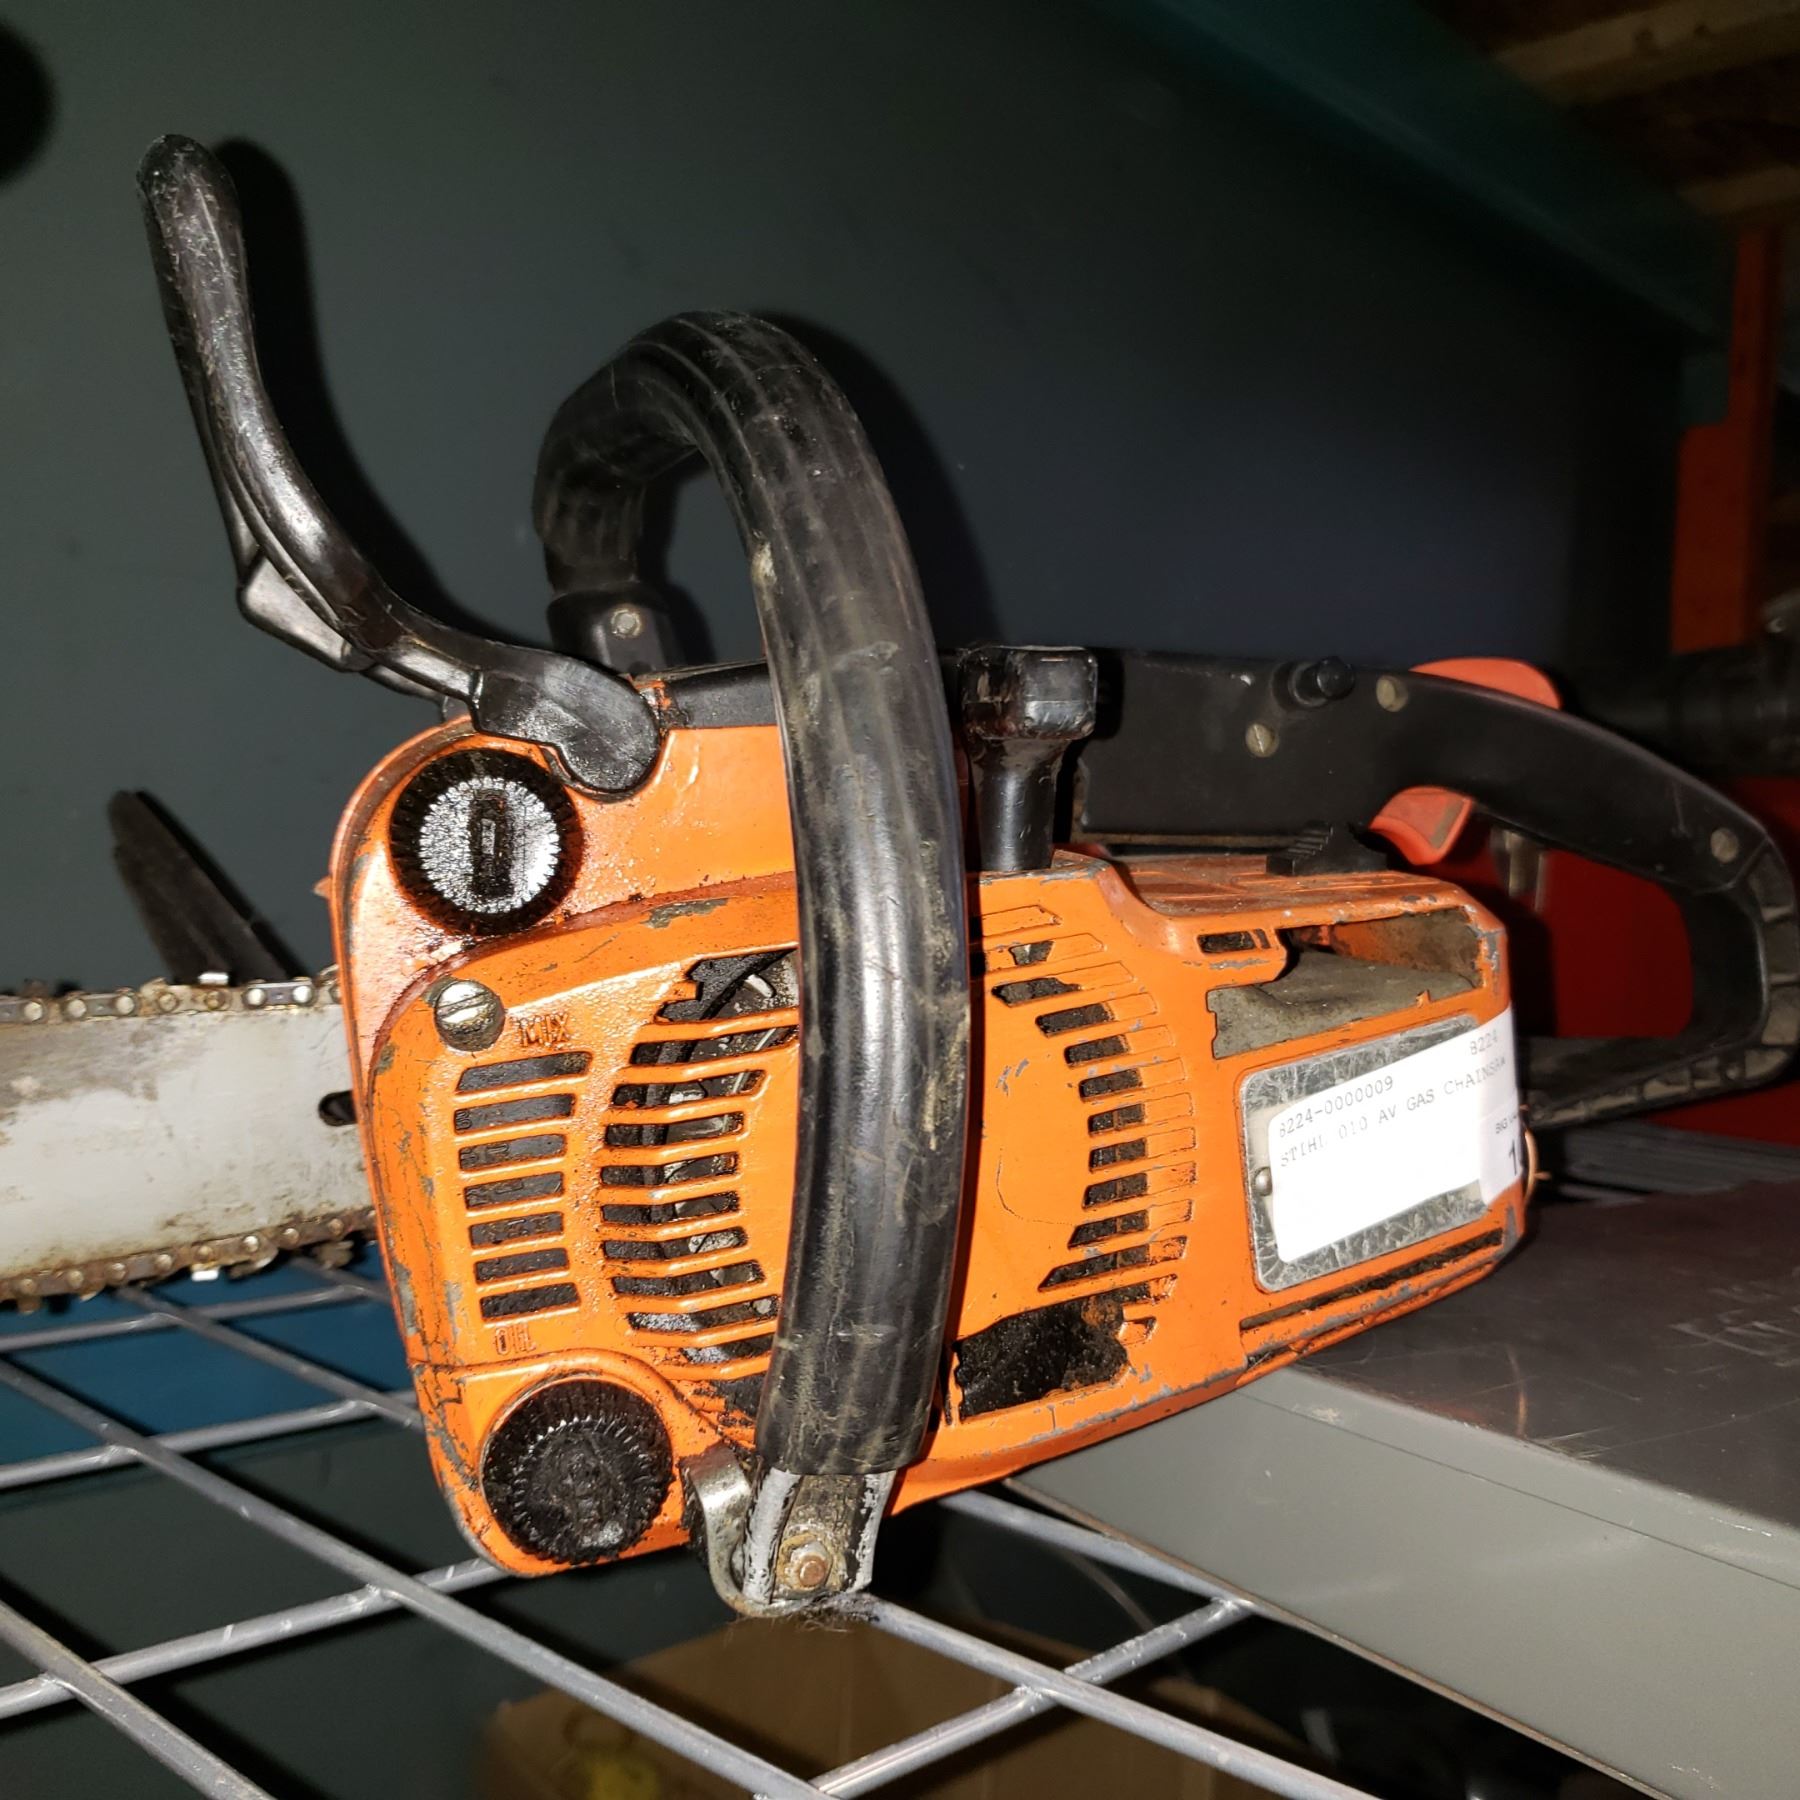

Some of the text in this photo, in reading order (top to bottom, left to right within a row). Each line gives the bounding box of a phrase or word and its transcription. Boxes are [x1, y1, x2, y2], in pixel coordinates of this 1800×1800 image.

[516, 1012, 570, 1048] MIX
[1280, 1075, 1393, 1138] 8224-0000009
[1338, 1115, 1368, 1139] 010
[1378, 1105, 1396, 1124] AV
[1406, 1088, 1435, 1111] GAS
[494, 1323, 537, 1355] OIL
